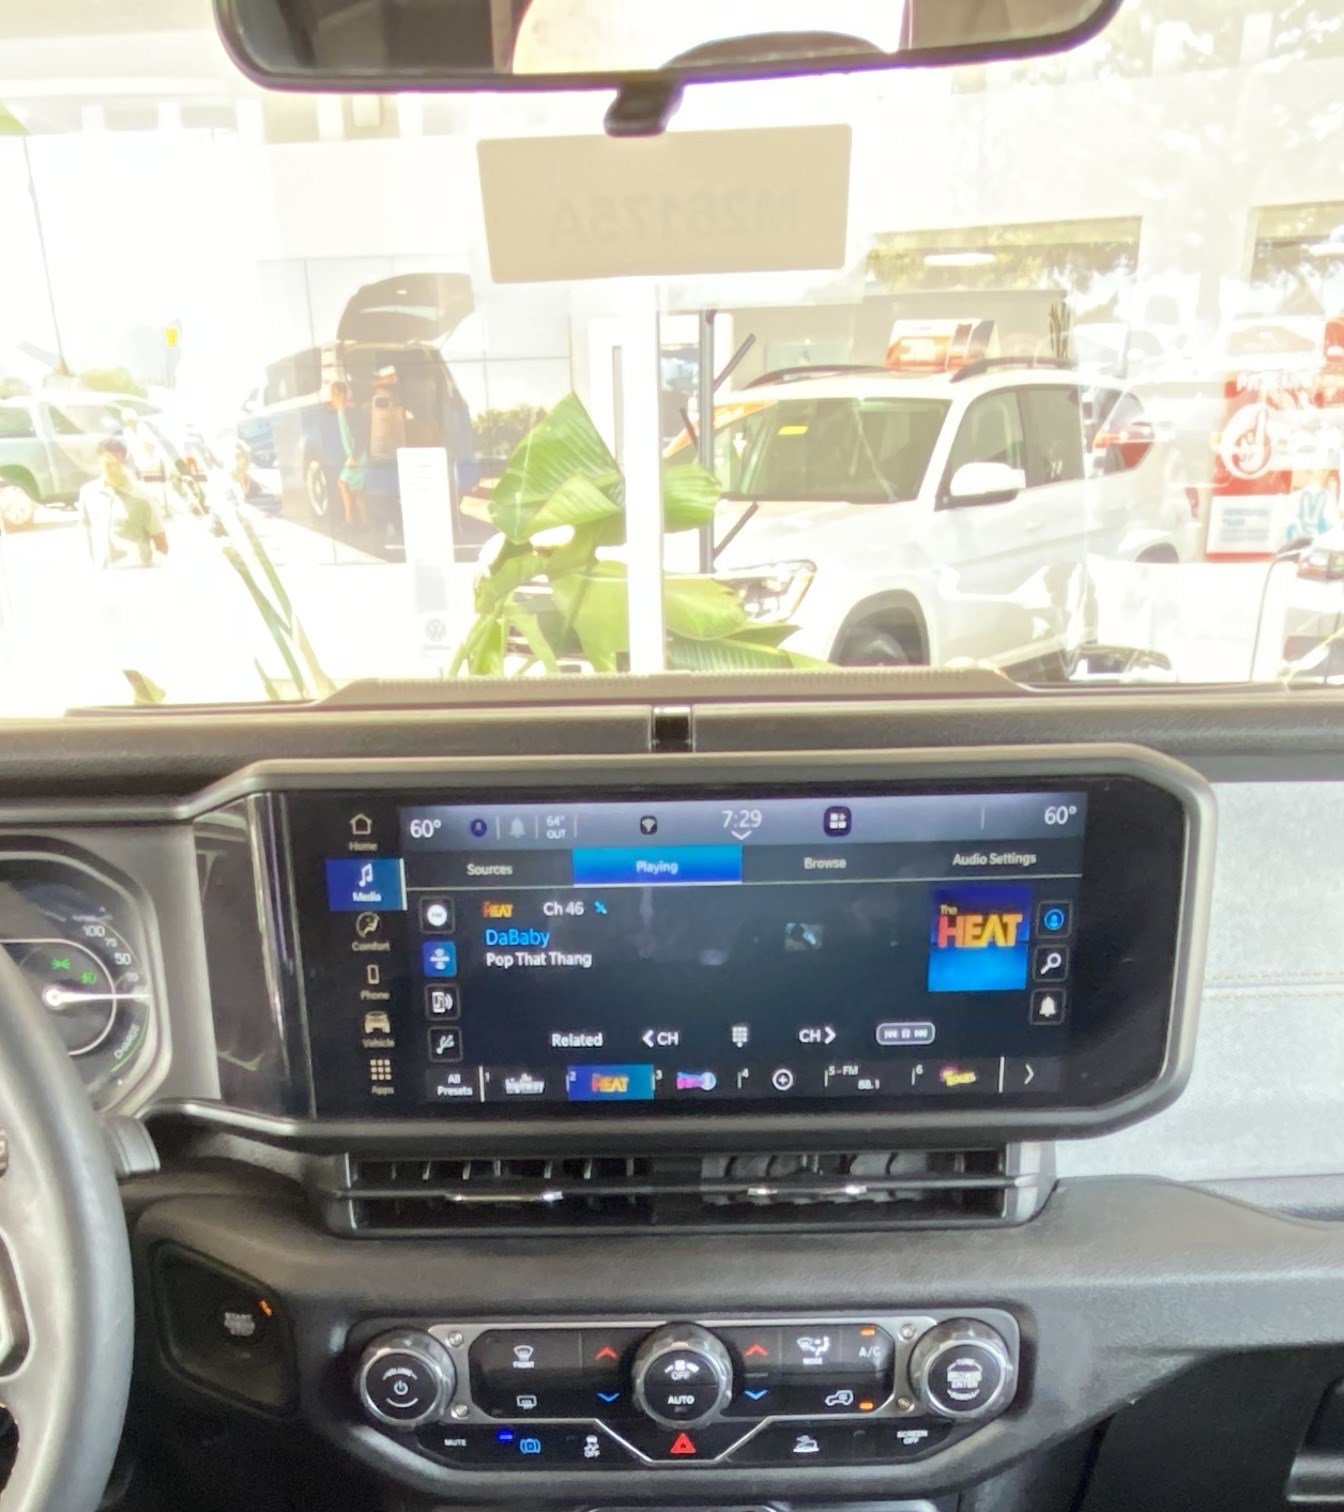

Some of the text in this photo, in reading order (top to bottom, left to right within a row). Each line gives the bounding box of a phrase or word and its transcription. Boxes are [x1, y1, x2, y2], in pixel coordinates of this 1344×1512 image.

[722, 809, 762, 828] 7:29
[1044, 804, 1077, 825] 60°
[803, 856, 847, 870] Browse
[953, 851, 1037, 868] Audio Settings
[466, 863, 513, 876] Sources
[636, 859, 679, 875] Playing
[543, 902, 563, 916] Ch
[565, 902, 584, 916] 46
[83, 925, 105, 938] 100
[937, 913, 1023, 948] HEAT
[485, 929, 550, 949] DaBaby
[114, 952, 132, 966] 50
[486, 951, 593, 970] Pop That Thang
[552, 1032, 603, 1048] Related
[656, 1032, 679, 1046] CH
[798, 1029, 822, 1043] CH
[858, 1345, 882, 1358] A/C
[667, 1394, 695, 1405] AUTO
[444, 1438, 467, 1447] MUTE
